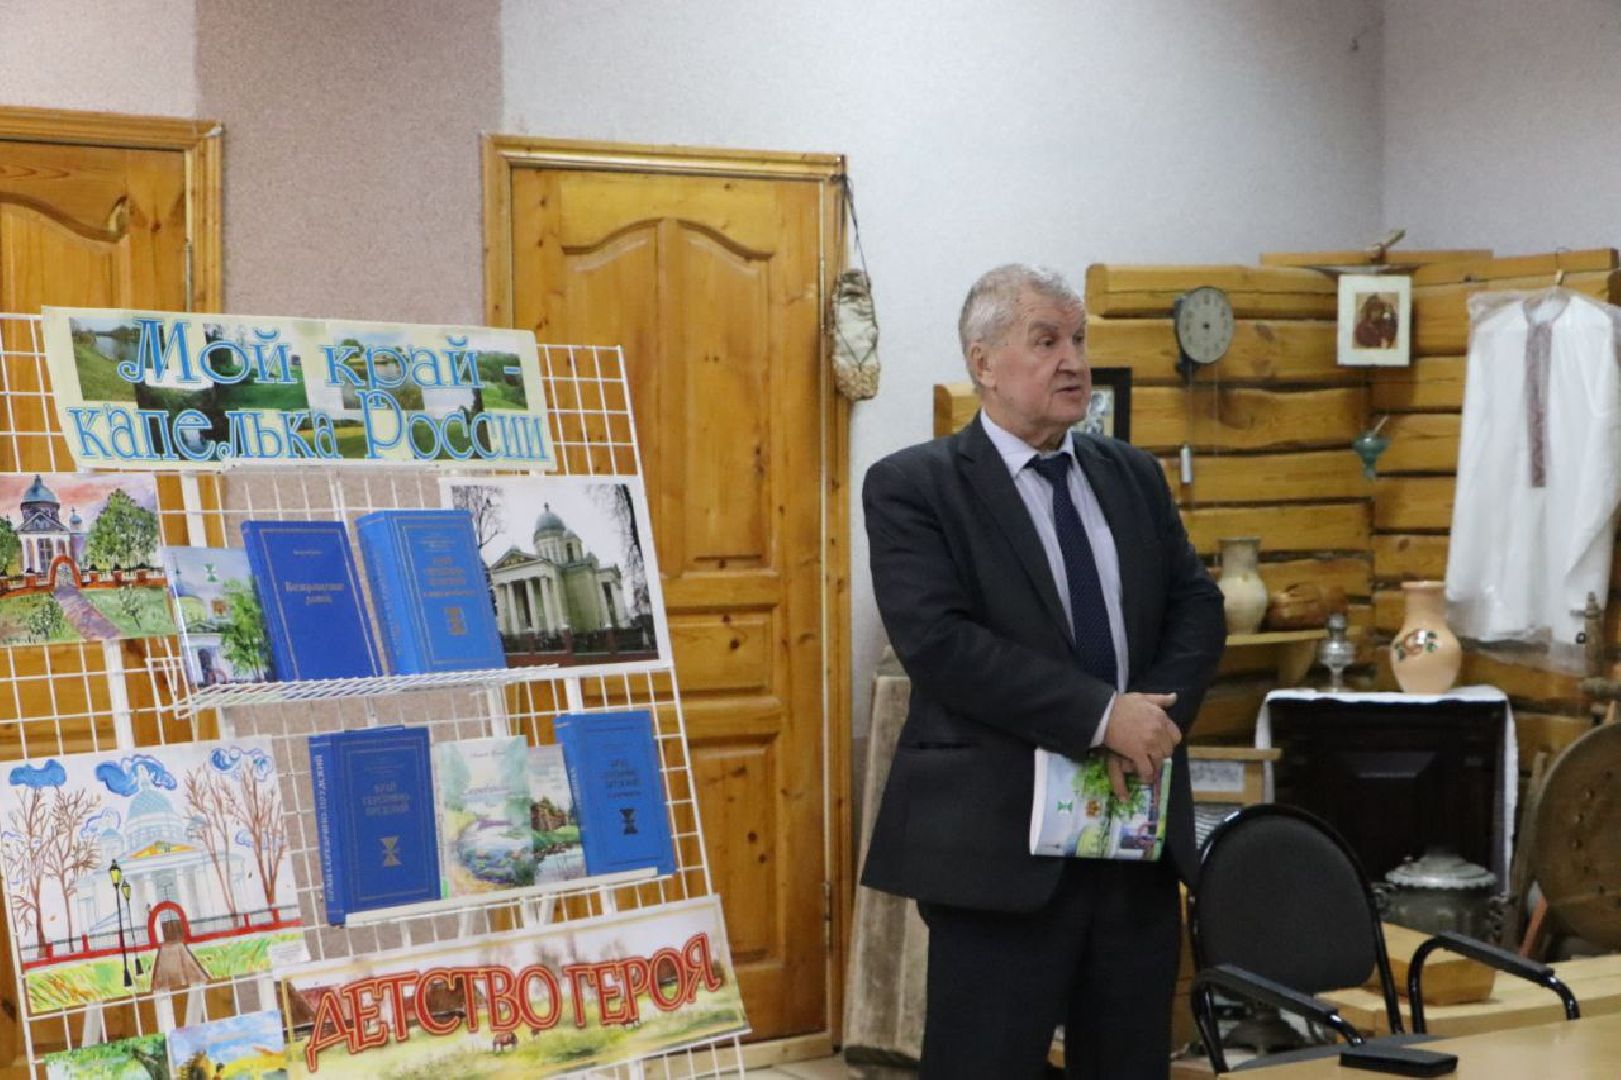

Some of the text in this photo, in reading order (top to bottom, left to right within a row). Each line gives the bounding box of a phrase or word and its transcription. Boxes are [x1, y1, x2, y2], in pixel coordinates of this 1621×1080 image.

[116, 317, 298, 385] Мой
[318, 334, 486, 409] край
[65, 387, 551, 462] капелька России
[305, 932, 721, 1073] ДЕТСТВО ГЕРОЯ
